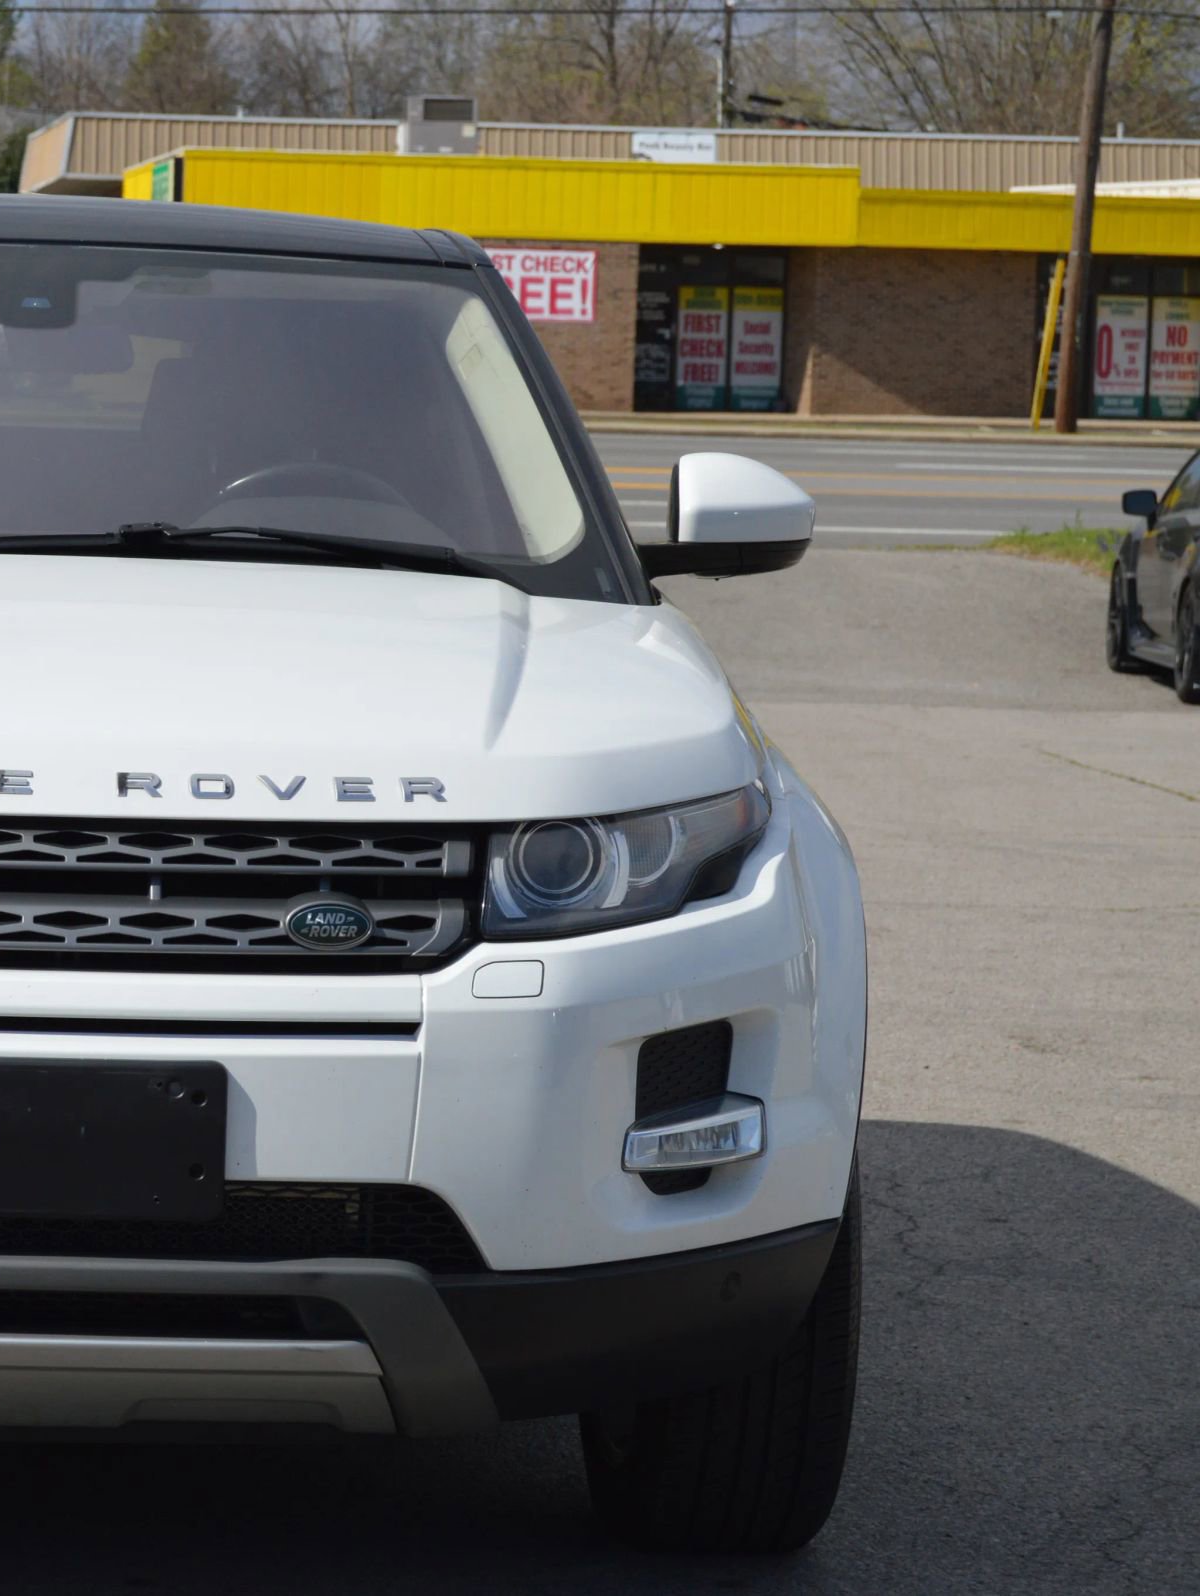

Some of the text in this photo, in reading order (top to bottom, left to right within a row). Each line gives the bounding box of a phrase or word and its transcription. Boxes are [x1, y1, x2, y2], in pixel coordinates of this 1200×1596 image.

[521, 255, 590, 273] CHECK
[683, 313, 722, 334] FIRST
[1166, 324, 1189, 348] NO
[679, 338, 725, 358] CHECK
[1151, 351, 1199, 365] PAYMENT
[116, 771, 448, 803] ROVER
[306, 912, 346, 925] LAND
[309, 925, 358, 938] ROVER
